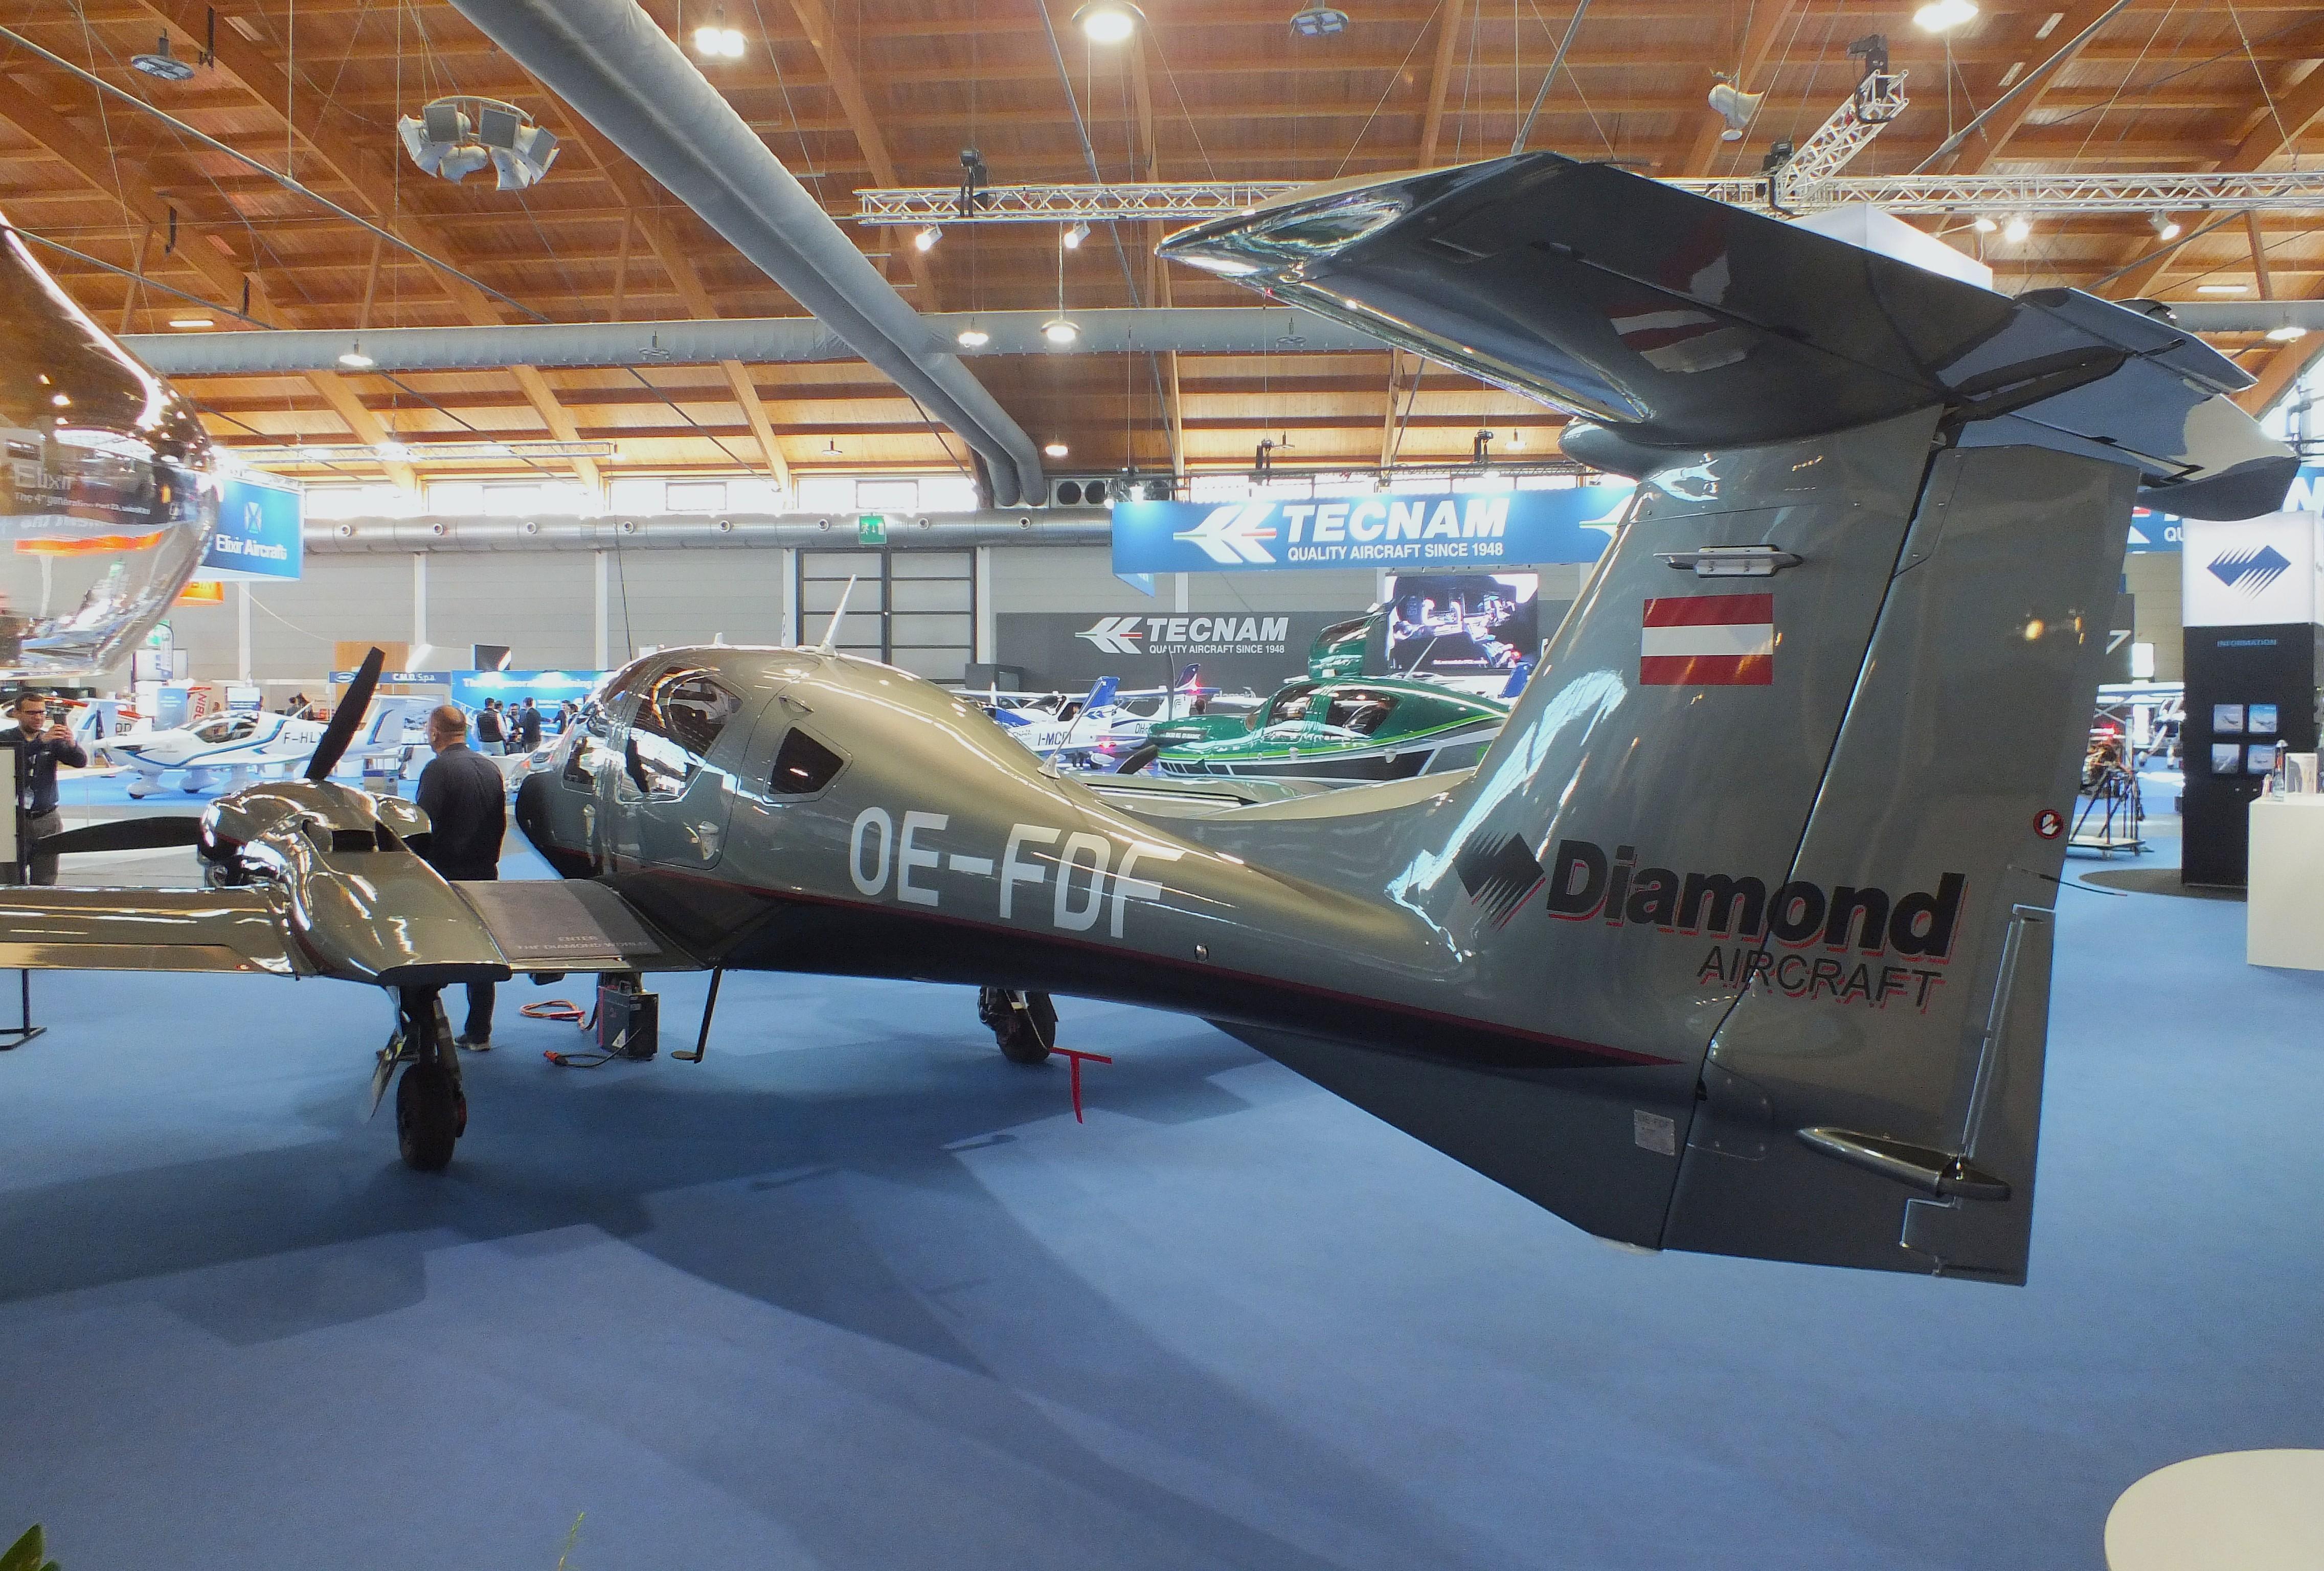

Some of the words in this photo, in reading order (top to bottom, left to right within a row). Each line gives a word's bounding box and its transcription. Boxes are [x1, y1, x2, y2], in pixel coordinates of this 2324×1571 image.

[1282, 498, 1510, 543] TECNAM
[216, 534, 243, 554] Elixir
[1288, 546, 1347, 562] QUALITY
[1350, 544, 1421, 559] AIRCRAFT
[1425, 543, 1468, 557] SINCE
[1472, 542, 1504, 556] 1948
[1146, 617, 1289, 642] TECNAM
[1149, 645, 1187, 655] QUALITY
[1189, 645, 1234, 654] AIRCRAFT
[1236, 645, 1262, 654] SINCE
[1266, 645, 1285, 654] 1948
[2217, 639, 2277, 647] INFORMATION
[849, 806, 1187, 939] OE-FDF
[1545, 839, 1969, 964] Diamond
[1695, 945, 1946, 1014] AIRCRAFT
